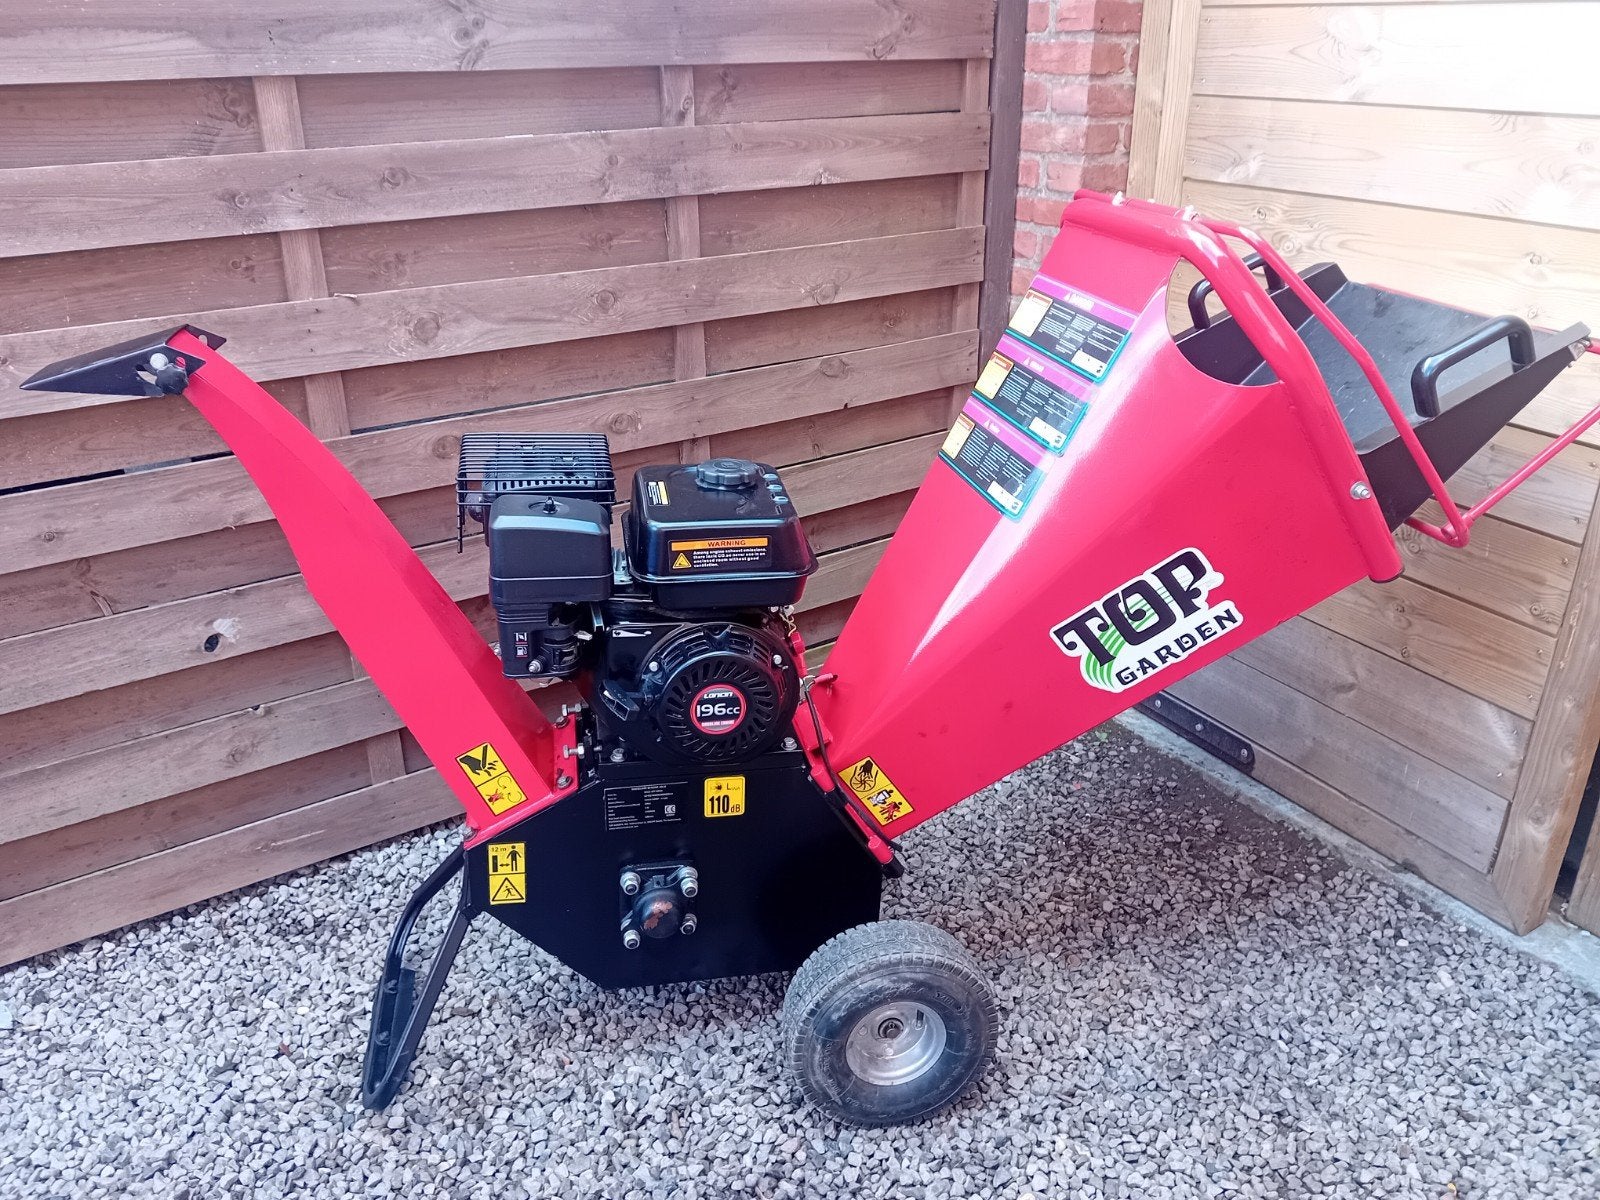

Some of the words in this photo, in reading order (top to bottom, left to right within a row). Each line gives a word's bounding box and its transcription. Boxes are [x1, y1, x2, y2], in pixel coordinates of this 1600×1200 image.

[707, 539, 746, 548] WARNING
[1053, 551, 1208, 668] TOP
[1115, 608, 1239, 686] GARDEN
[708, 794, 730, 814] 110
[730, 803, 741, 813] dB
